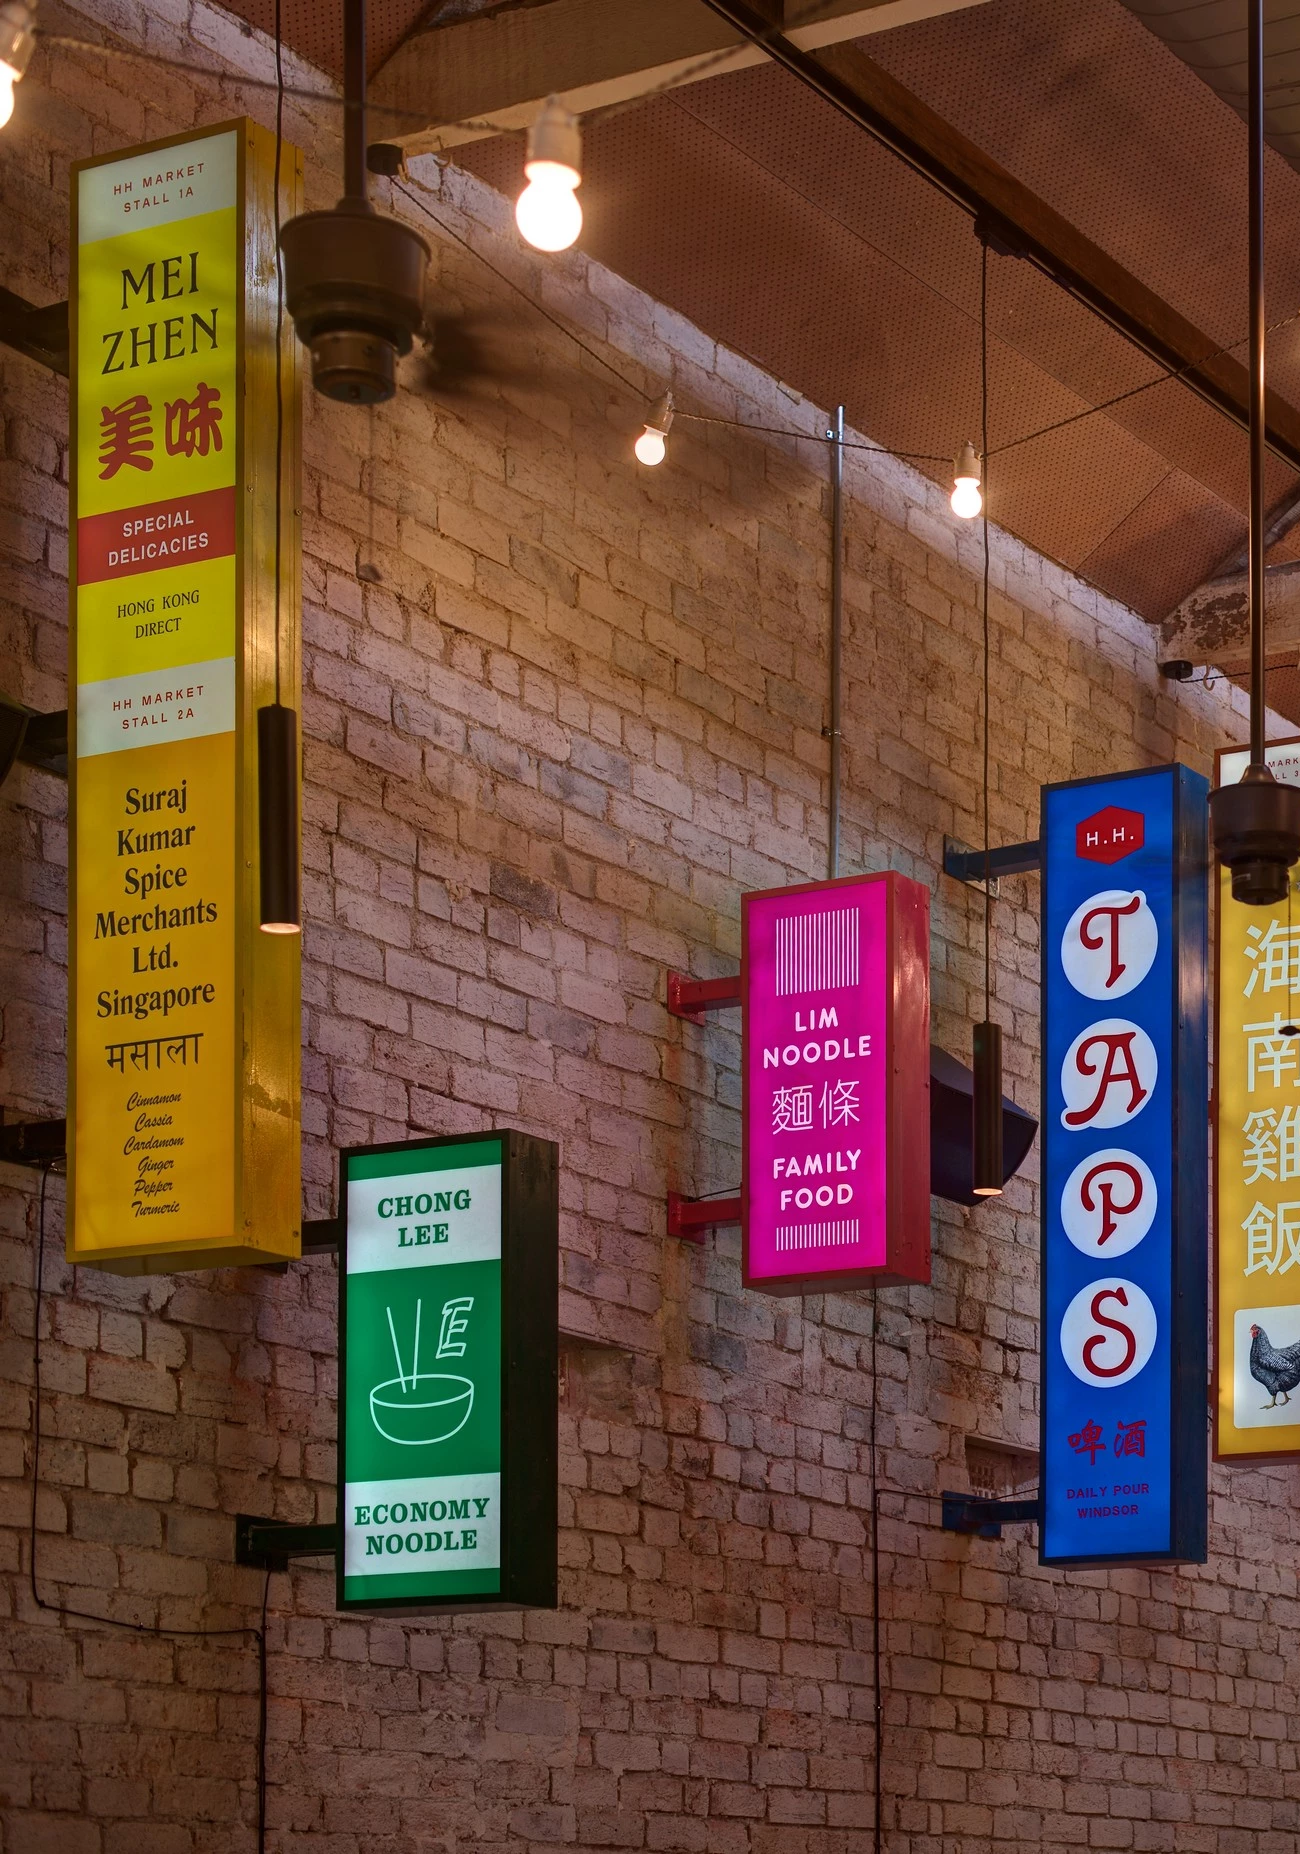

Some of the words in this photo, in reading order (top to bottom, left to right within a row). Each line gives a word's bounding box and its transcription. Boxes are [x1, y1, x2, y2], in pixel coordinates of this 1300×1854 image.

[113, 181, 133, 196] HH
[142, 162, 206, 189] MARKET
[123, 193, 170, 213] STALL
[179, 186, 194, 200] 1A
[121, 251, 200, 310] MEI
[101, 308, 219, 375] ZHEN
[98, 382, 223, 481] 美味
[122, 510, 195, 538] SPECIAL
[108, 532, 209, 567] DELICACIES
[117, 599, 156, 619] HONG
[162, 589, 201, 610] KONG
[135, 617, 182, 639] DIRECT
[113, 698, 133, 712] HH
[142, 685, 205, 706] MARKET
[122, 712, 168, 730] STALL
[178, 707, 194, 720] 2A
[125, 779, 188, 815] Suraj
[117, 825, 196, 857] Kumar
[1086, 826, 1135, 847] H.H.
[124, 863, 188, 900] Spice
[94, 898, 218, 939] Merchants
[132, 942, 179, 974] Ltd.
[96, 982, 216, 1020] Singapore
[794, 1006, 839, 1033] LIM
[105, 1032, 204, 1074] मसाला
[762, 1035, 872, 1070] NOODLE
[126, 1091, 182, 1112] Cinnamon
[771, 1078, 861, 1136] 麵條
[134, 1112, 173, 1133] Cassia
[123, 1136, 185, 1156] Cardamom
[137, 1156, 175, 1178] Ginger
[772, 1148, 862, 1180] FAMILY
[133, 1179, 174, 1198] Pepper
[780, 1183, 854, 1212] FOOD
[131, 1200, 181, 1218] Turmeric
[377, 1189, 472, 1219] CHONG
[397, 1223, 450, 1248] LEE
[1067, 1418, 1148, 1467] 啤酒
[1066, 1486, 1108, 1500] DAILY
[1113, 1482, 1150, 1497] POUR
[354, 1497, 491, 1526] ECONOMY
[1077, 1504, 1139, 1520] WINDSOR
[365, 1529, 478, 1556] NOODLE
